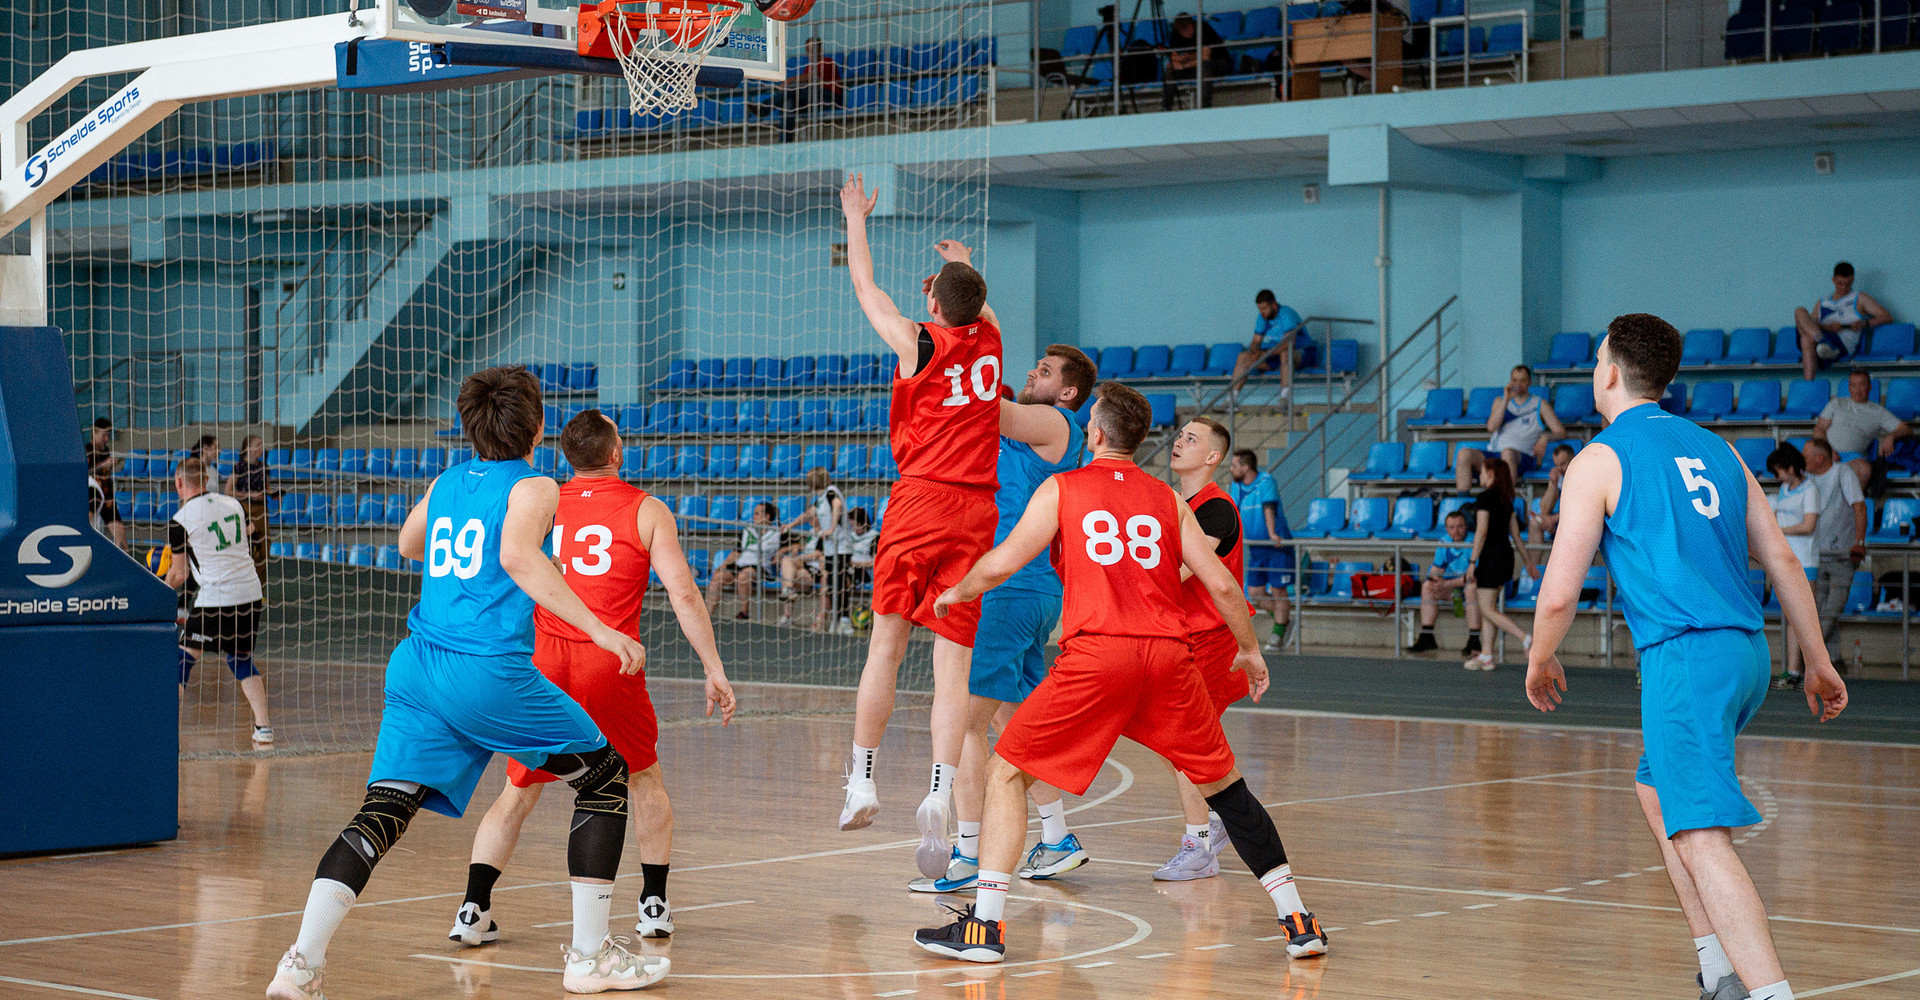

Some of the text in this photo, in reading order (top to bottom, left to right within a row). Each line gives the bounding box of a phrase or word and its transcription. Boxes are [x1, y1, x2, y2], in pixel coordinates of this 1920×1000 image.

[729, 31, 767, 43] Schelde
[729, 40, 767, 52] Sports
[47, 87, 140, 163] Schelde Sports
[942, 355, 1000, 407] 10
[1674, 456, 1721, 520] 5
[207, 513, 242, 552] 17
[429, 516, 486, 580] 69
[1082, 509, 1162, 570] 88
[67, 595, 129, 616] Sports
